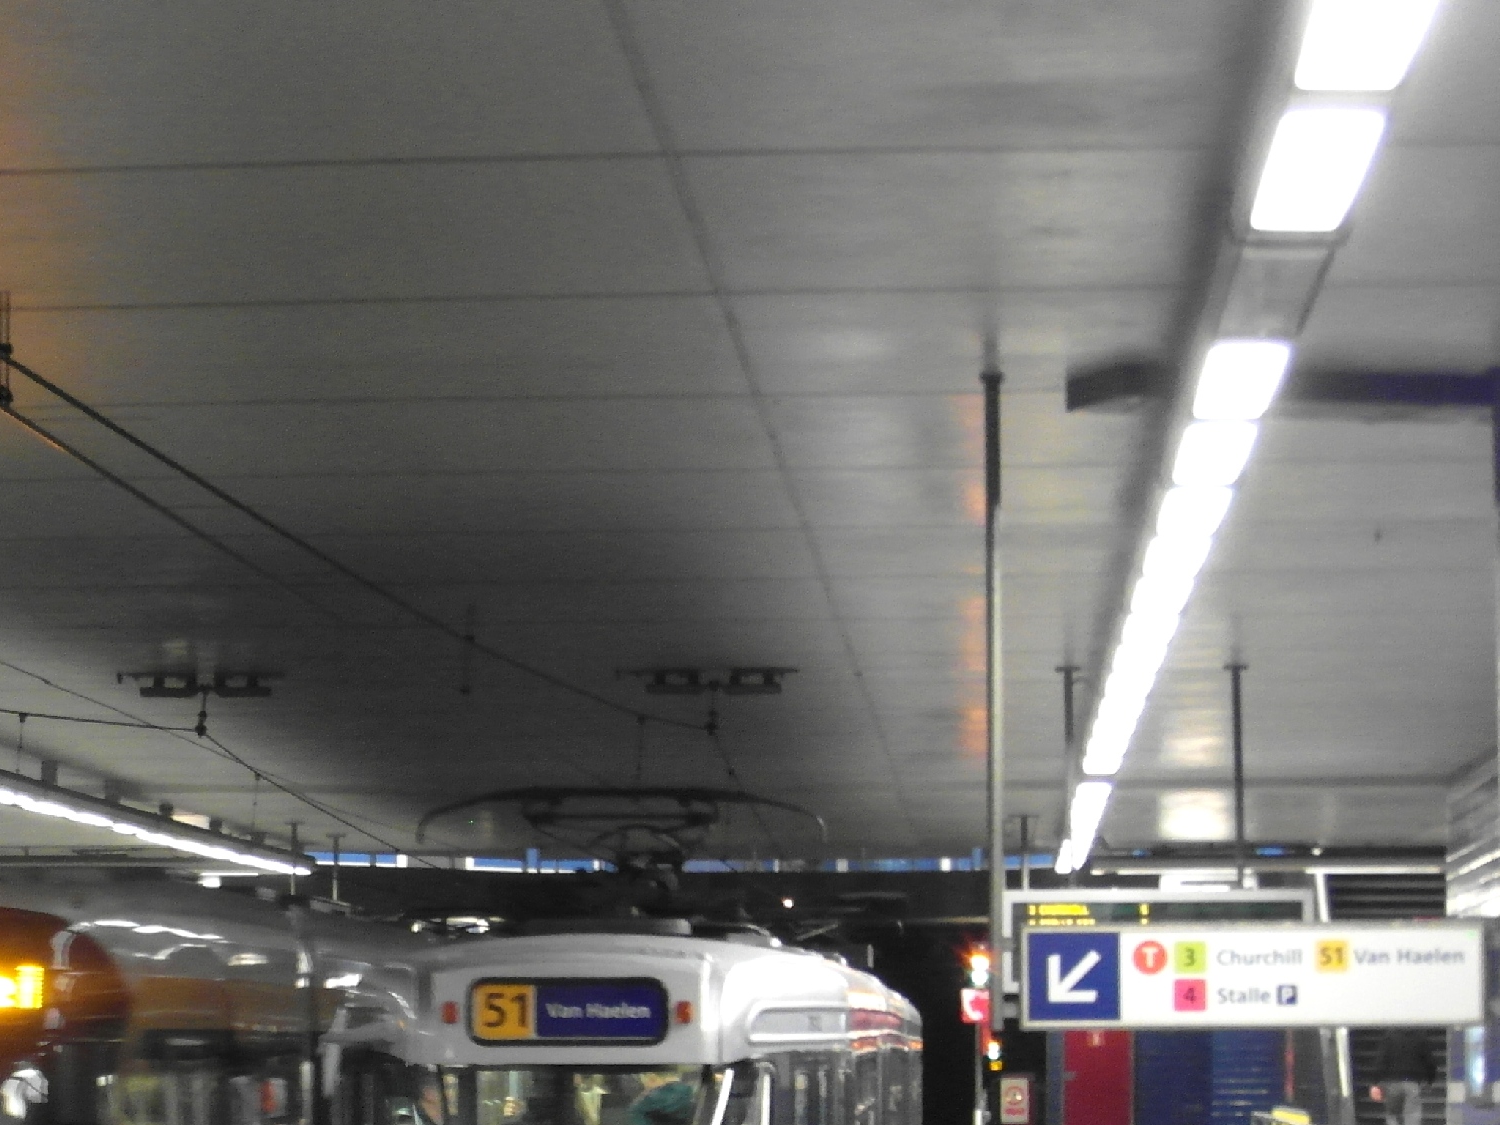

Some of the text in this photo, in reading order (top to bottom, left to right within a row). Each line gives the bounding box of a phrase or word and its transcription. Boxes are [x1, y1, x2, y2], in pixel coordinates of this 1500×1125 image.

[1183, 947, 1197, 968] 3
[1216, 948, 1303, 968] Churchill
[1319, 947, 1345, 967] 51
[1354, 948, 1391, 966] Van
[1396, 947, 1465, 966] Haelen
[1182, 986, 1198, 1006] 4
[1217, 987, 1271, 1006] Stalle
[481, 991, 651, 1029] 51 Van Haelen
